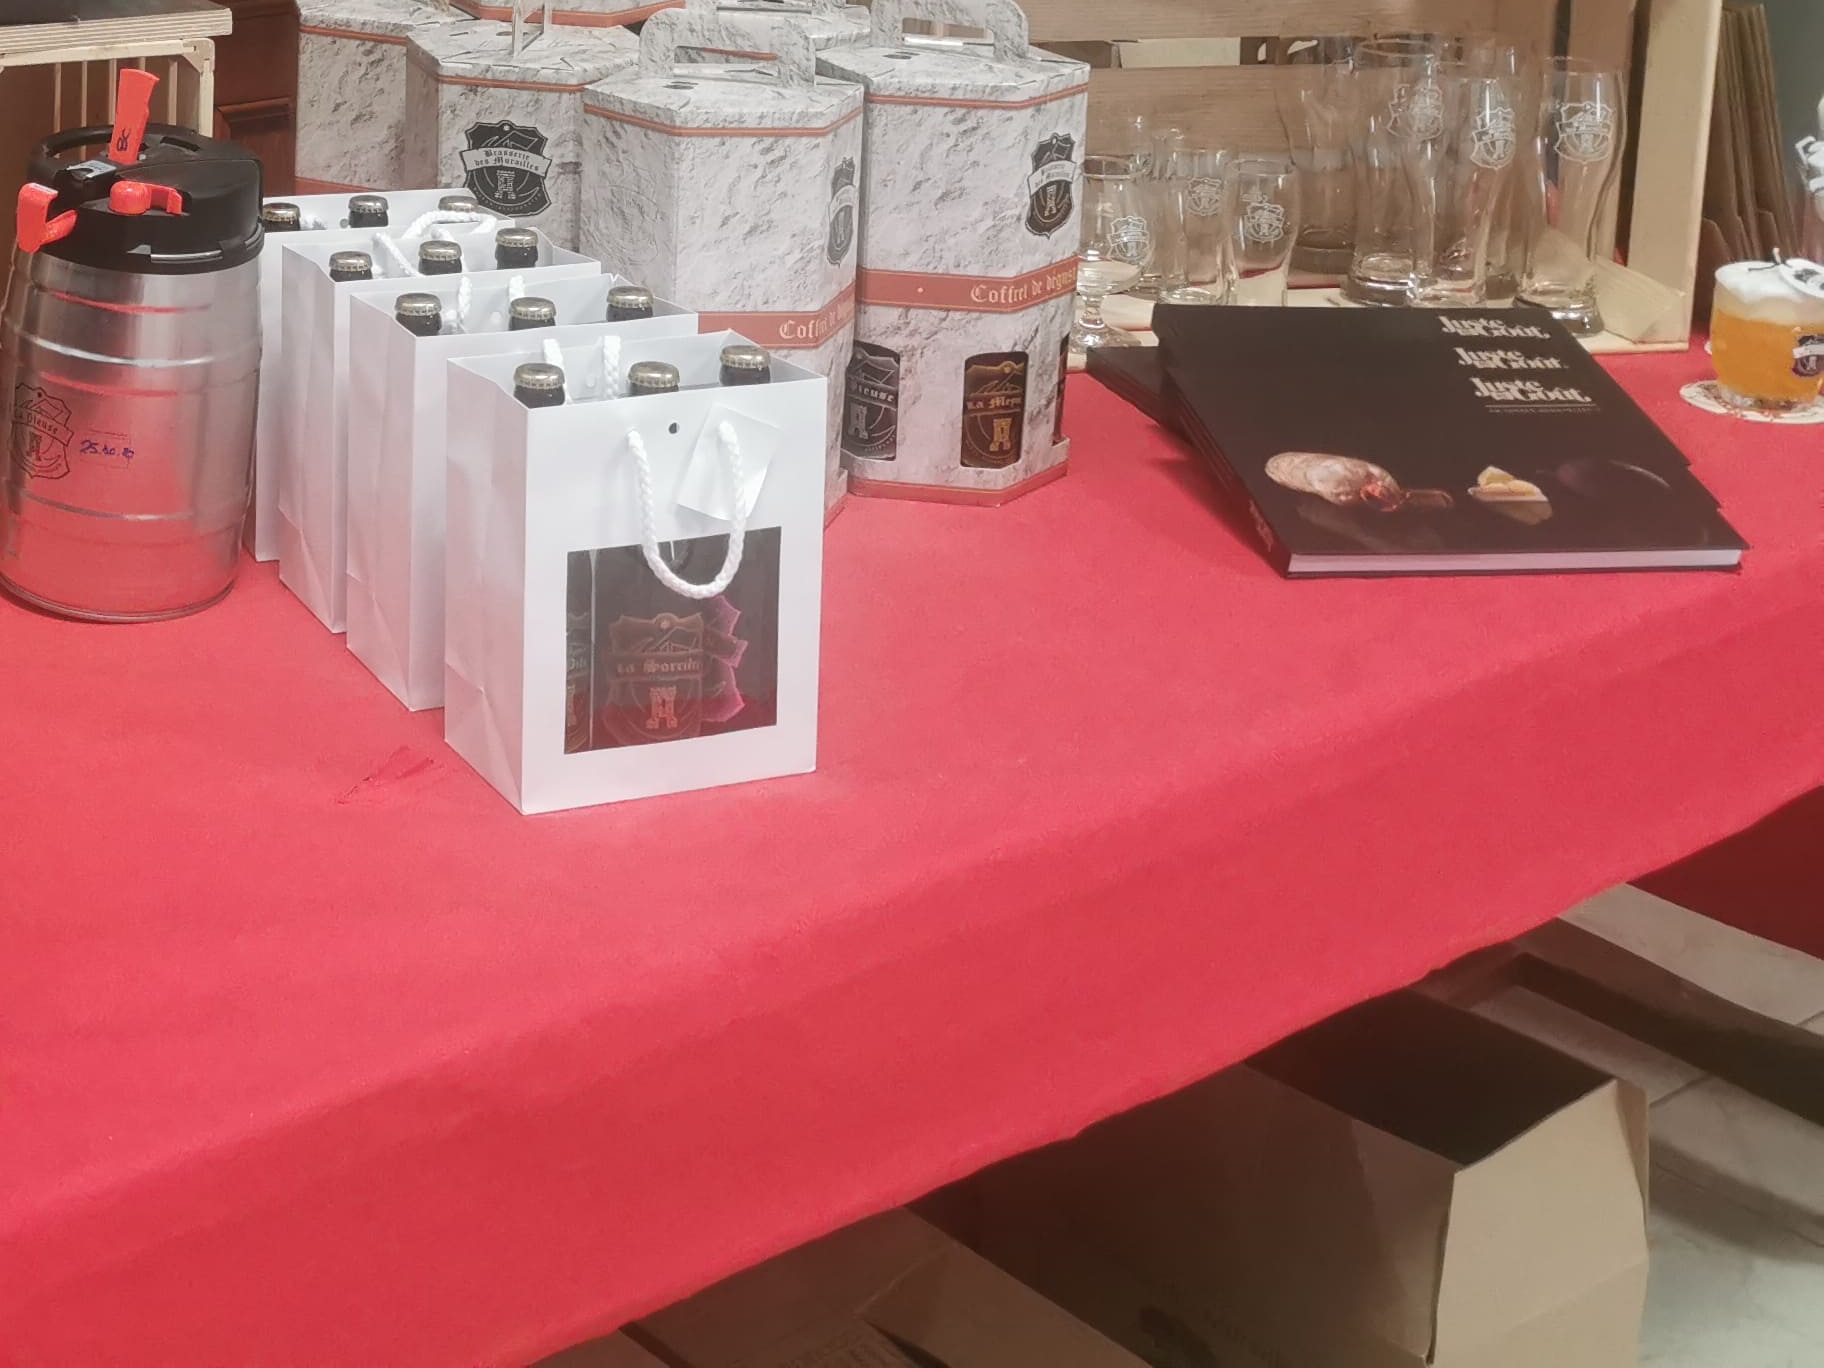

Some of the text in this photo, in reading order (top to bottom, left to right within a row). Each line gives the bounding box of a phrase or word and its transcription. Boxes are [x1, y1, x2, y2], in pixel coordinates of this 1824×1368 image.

[485, 149, 530, 161] Brasserie
[494, 157, 539, 171] Murailles
[971, 282, 1028, 304] Coffret
[1032, 279, 1044, 293] de
[1438, 316, 1505, 333] Juste
[1453, 347, 1525, 366] Juste
[1470, 377, 1544, 397] Juste
